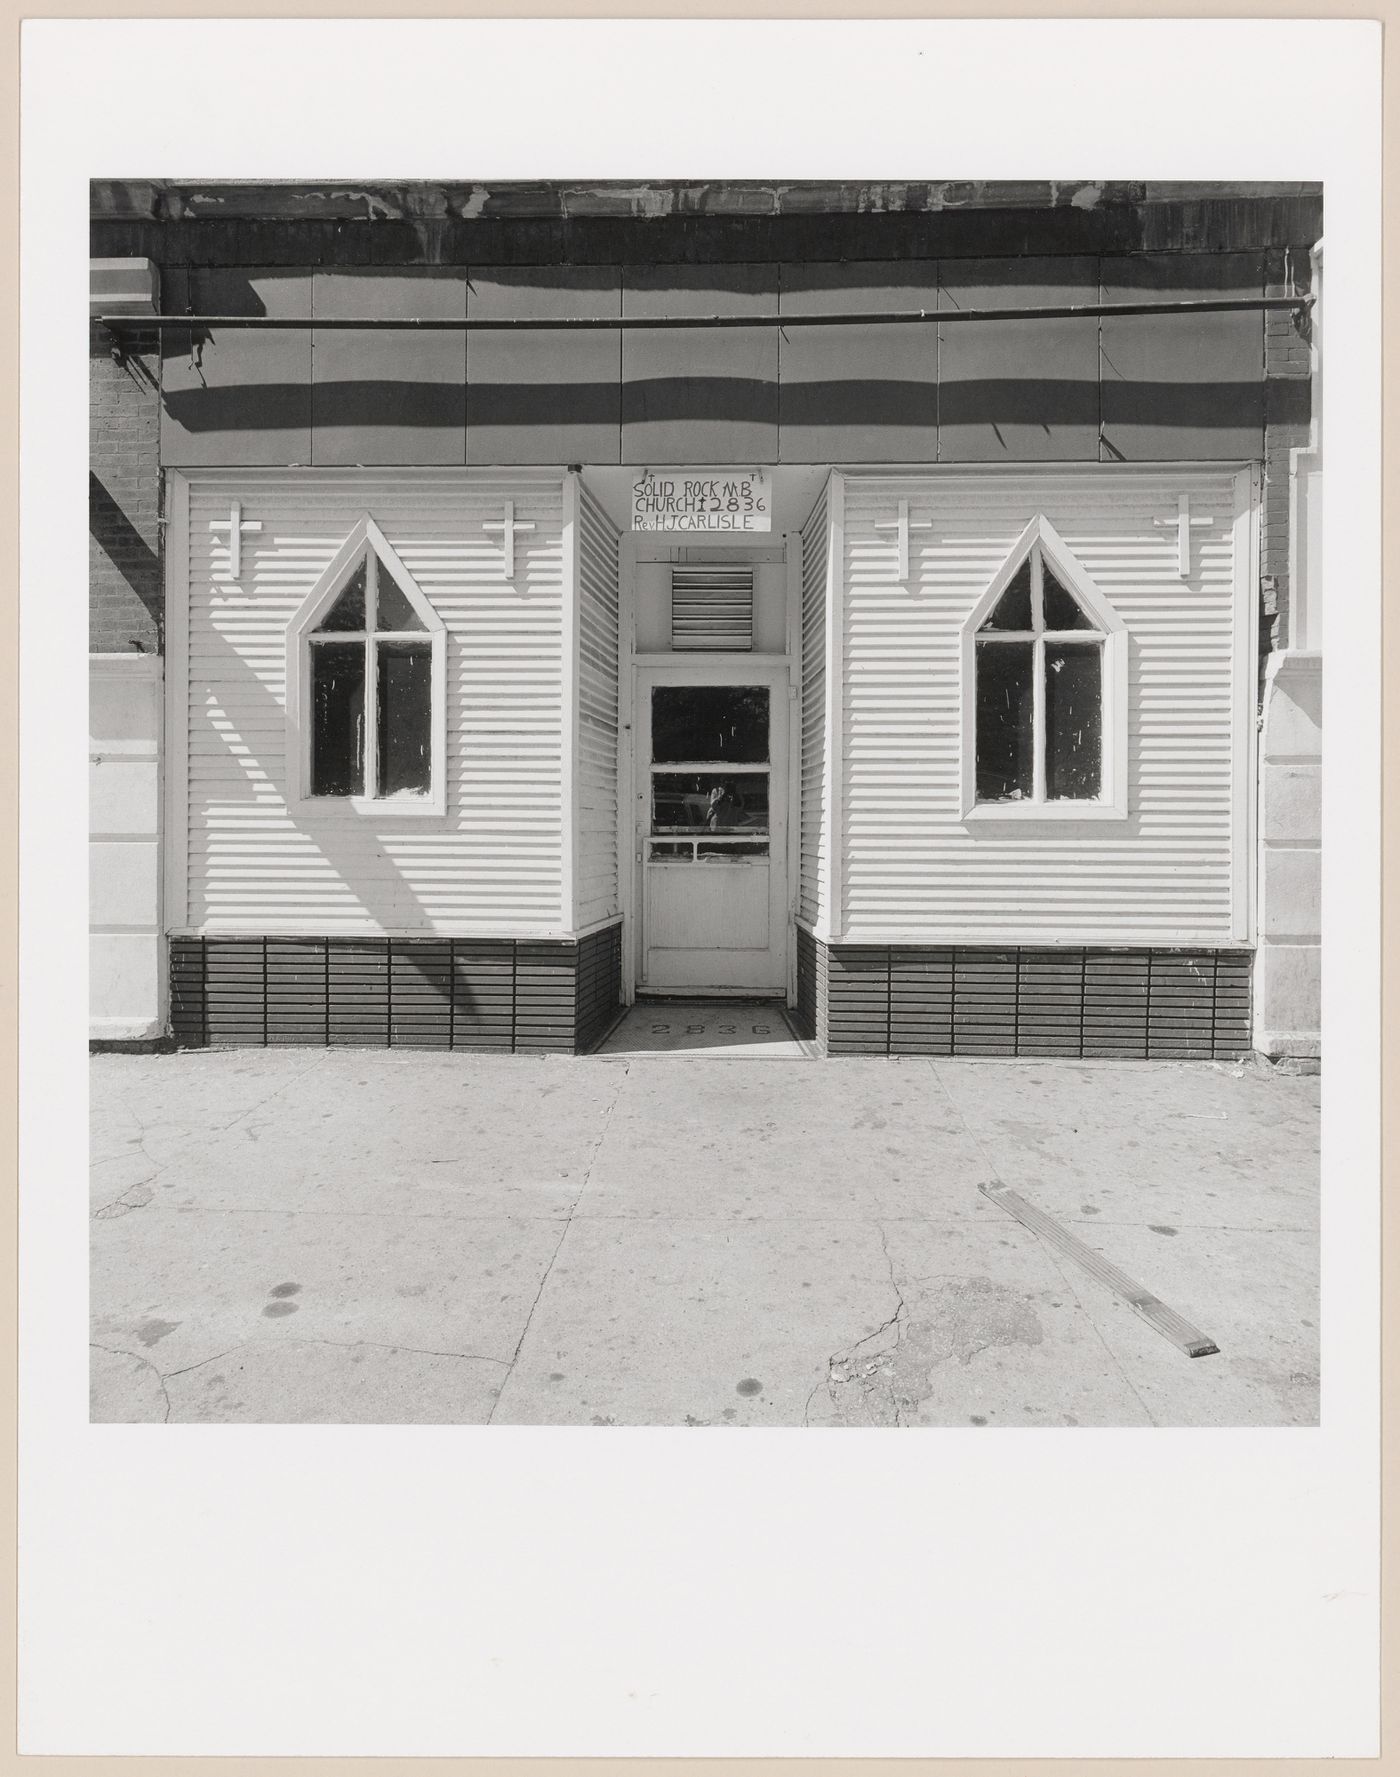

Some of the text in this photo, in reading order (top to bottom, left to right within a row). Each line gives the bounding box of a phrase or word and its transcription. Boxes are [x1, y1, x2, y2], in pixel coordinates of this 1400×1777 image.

[633, 481, 675, 497] SOLID
[683, 480, 720, 497] ROCK
[635, 497, 766, 512] CHURCH 2836
[651, 1024, 771, 1035] 2836
